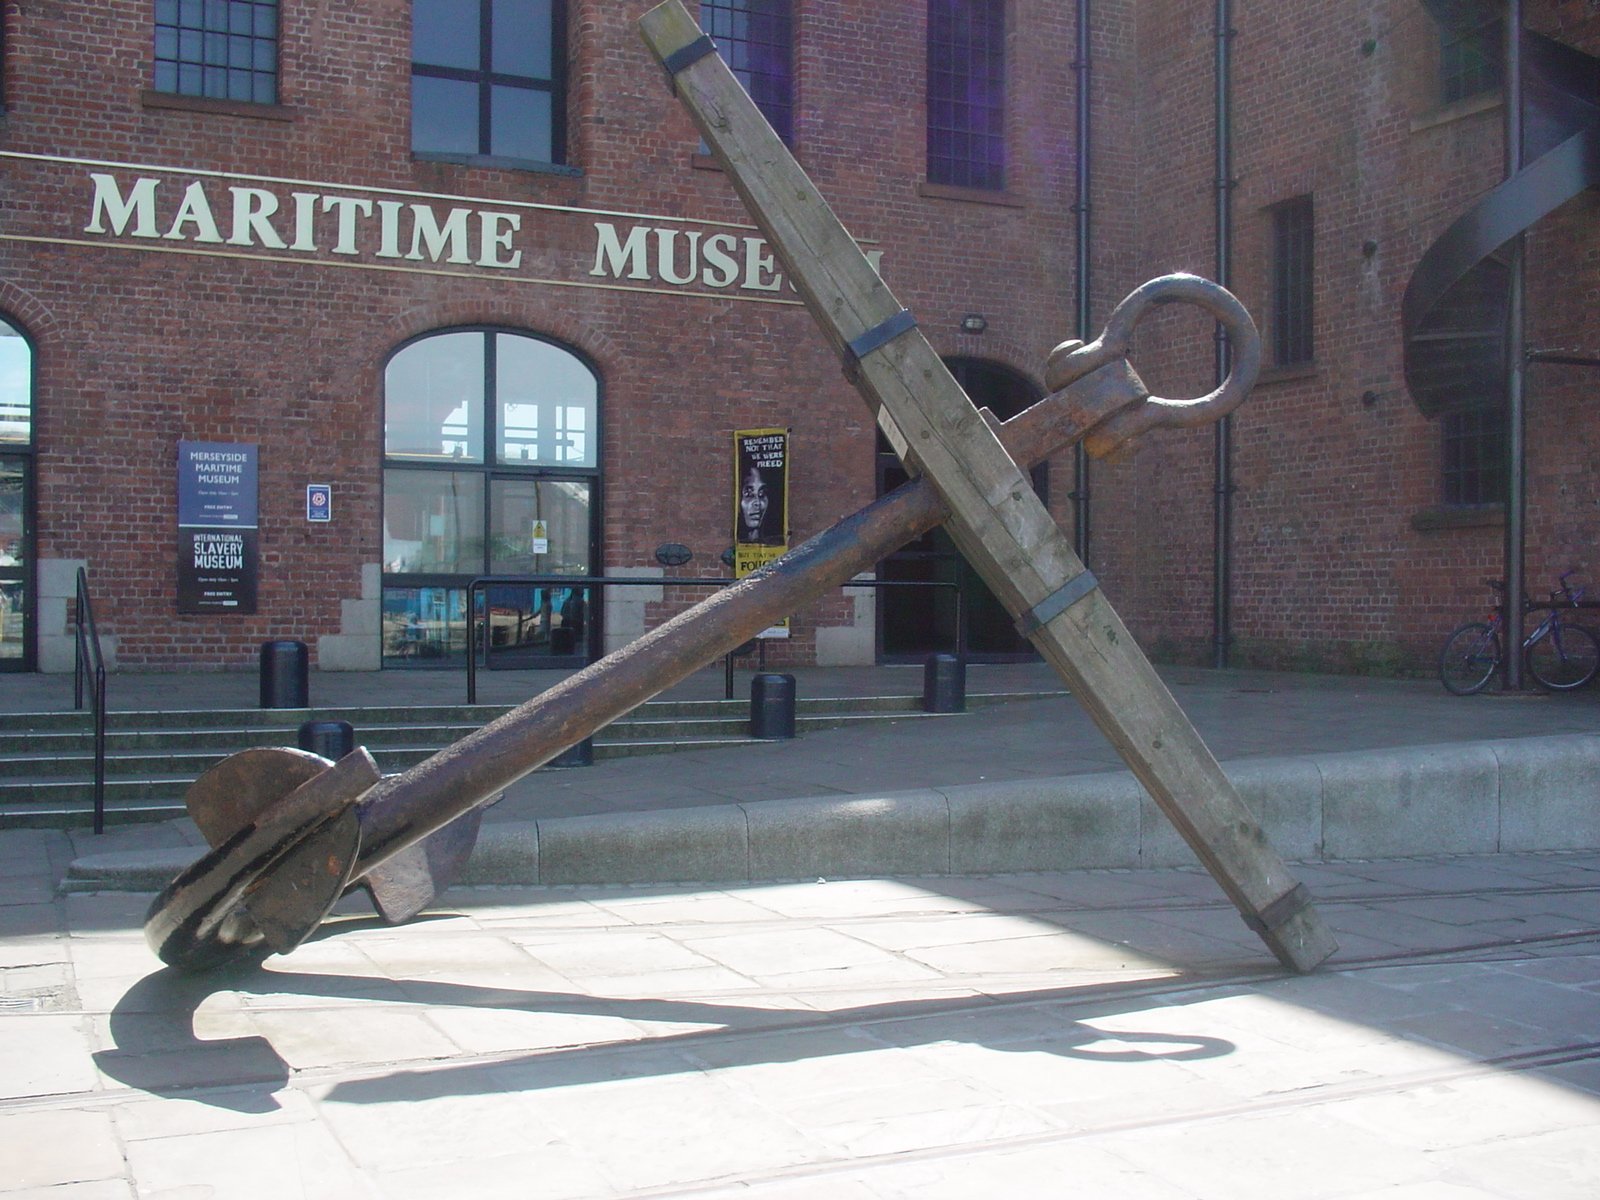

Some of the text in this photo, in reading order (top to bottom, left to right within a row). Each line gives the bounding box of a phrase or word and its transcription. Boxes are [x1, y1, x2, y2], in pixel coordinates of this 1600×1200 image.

[84, 173, 884, 293] MARITIME MUSE
[744, 436, 784, 445] REMEMBER
[745, 443, 783, 453] NOT THAT
[190, 452, 248, 462] MERSEYSIDE
[762, 450, 784, 459] WERE
[195, 463, 242, 473] MARITIME
[757, 460, 783, 468] FREED
[198, 474, 240, 484] MUSEUM
[193, 533, 242, 542] INTERNATIONAL
[194, 541, 243, 555] SLAVERY
[194, 554, 243, 569] MUSEUM
